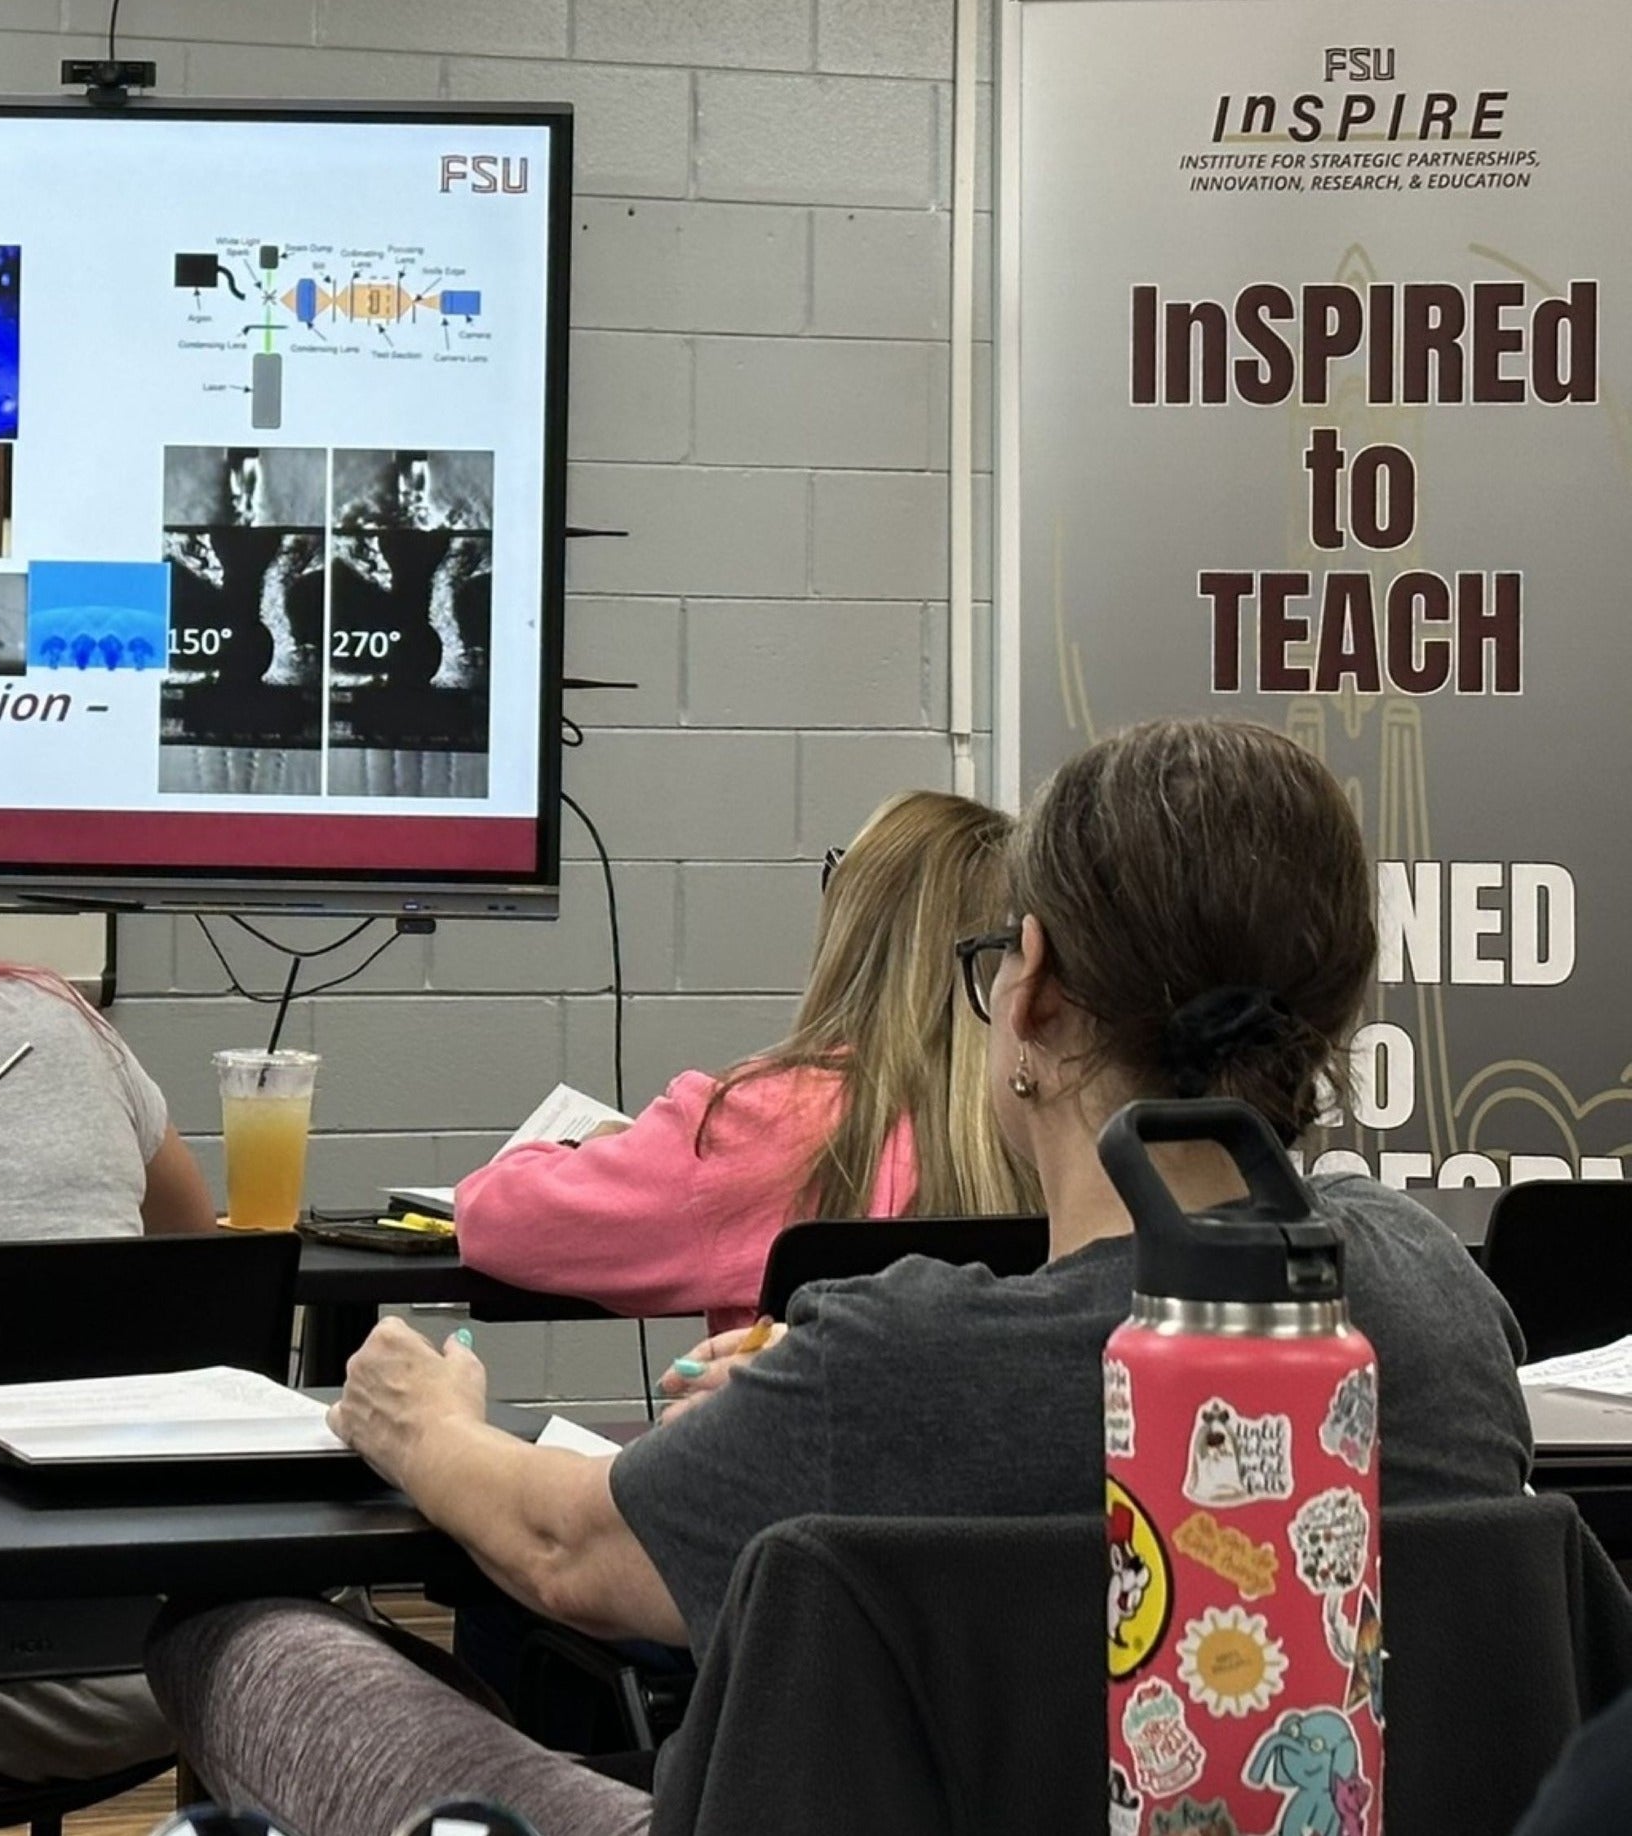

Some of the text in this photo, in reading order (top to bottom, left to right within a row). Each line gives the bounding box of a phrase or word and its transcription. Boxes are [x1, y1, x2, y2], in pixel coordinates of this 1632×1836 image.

[1323, 47, 1396, 82] FSU
[439, 155, 528, 193] FSU
[1180, 151, 1541, 170] INSTITUTE FOR STRATEGIC PARTNERSHIPS,
[1190, 173, 1531, 192] INNOVATION, RESEARCH, & EDUCATION
[1129, 280, 1599, 406] InSPIREd
[1304, 426, 1418, 551] to
[168, 628, 232, 656] 150°
[332, 631, 401, 658] 270°
[1197, 569, 1524, 696] TEACH
